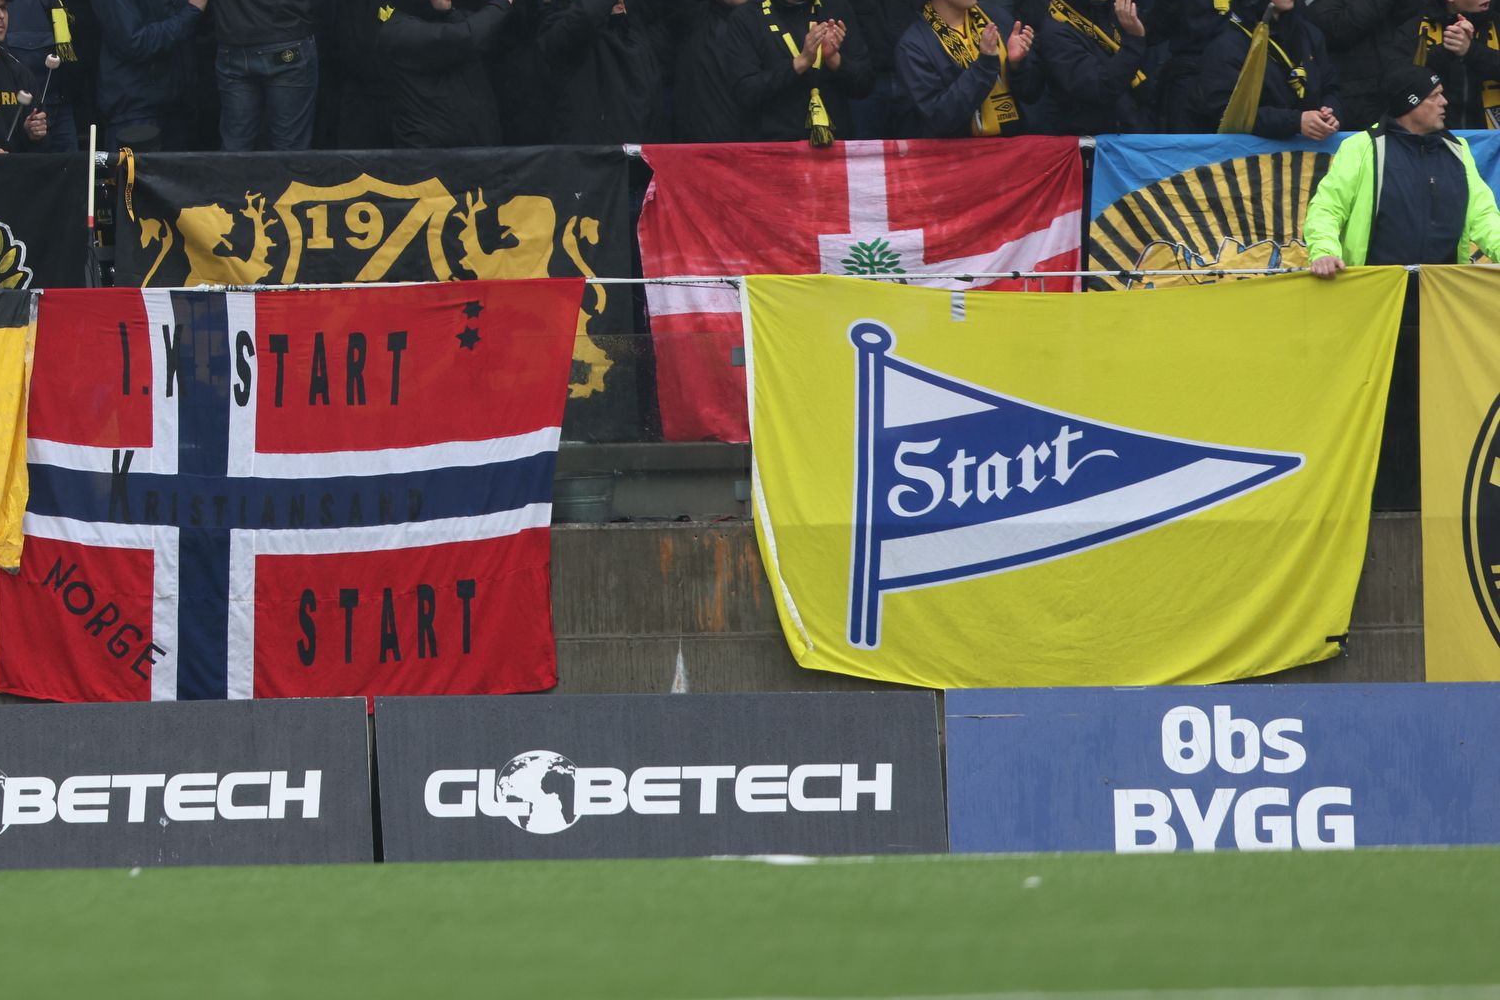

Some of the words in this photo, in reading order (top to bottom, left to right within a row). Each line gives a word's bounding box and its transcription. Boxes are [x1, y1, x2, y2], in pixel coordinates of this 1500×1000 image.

[306, 201, 384, 249] 19
[233, 330, 408, 408] START
[887, 425, 1119, 517] Start
[42, 557, 167, 681] NORGE
[297, 579, 476, 666] START
[1161, 705, 1307, 774] Obs
[1113, 786, 1355, 854] BYGG
